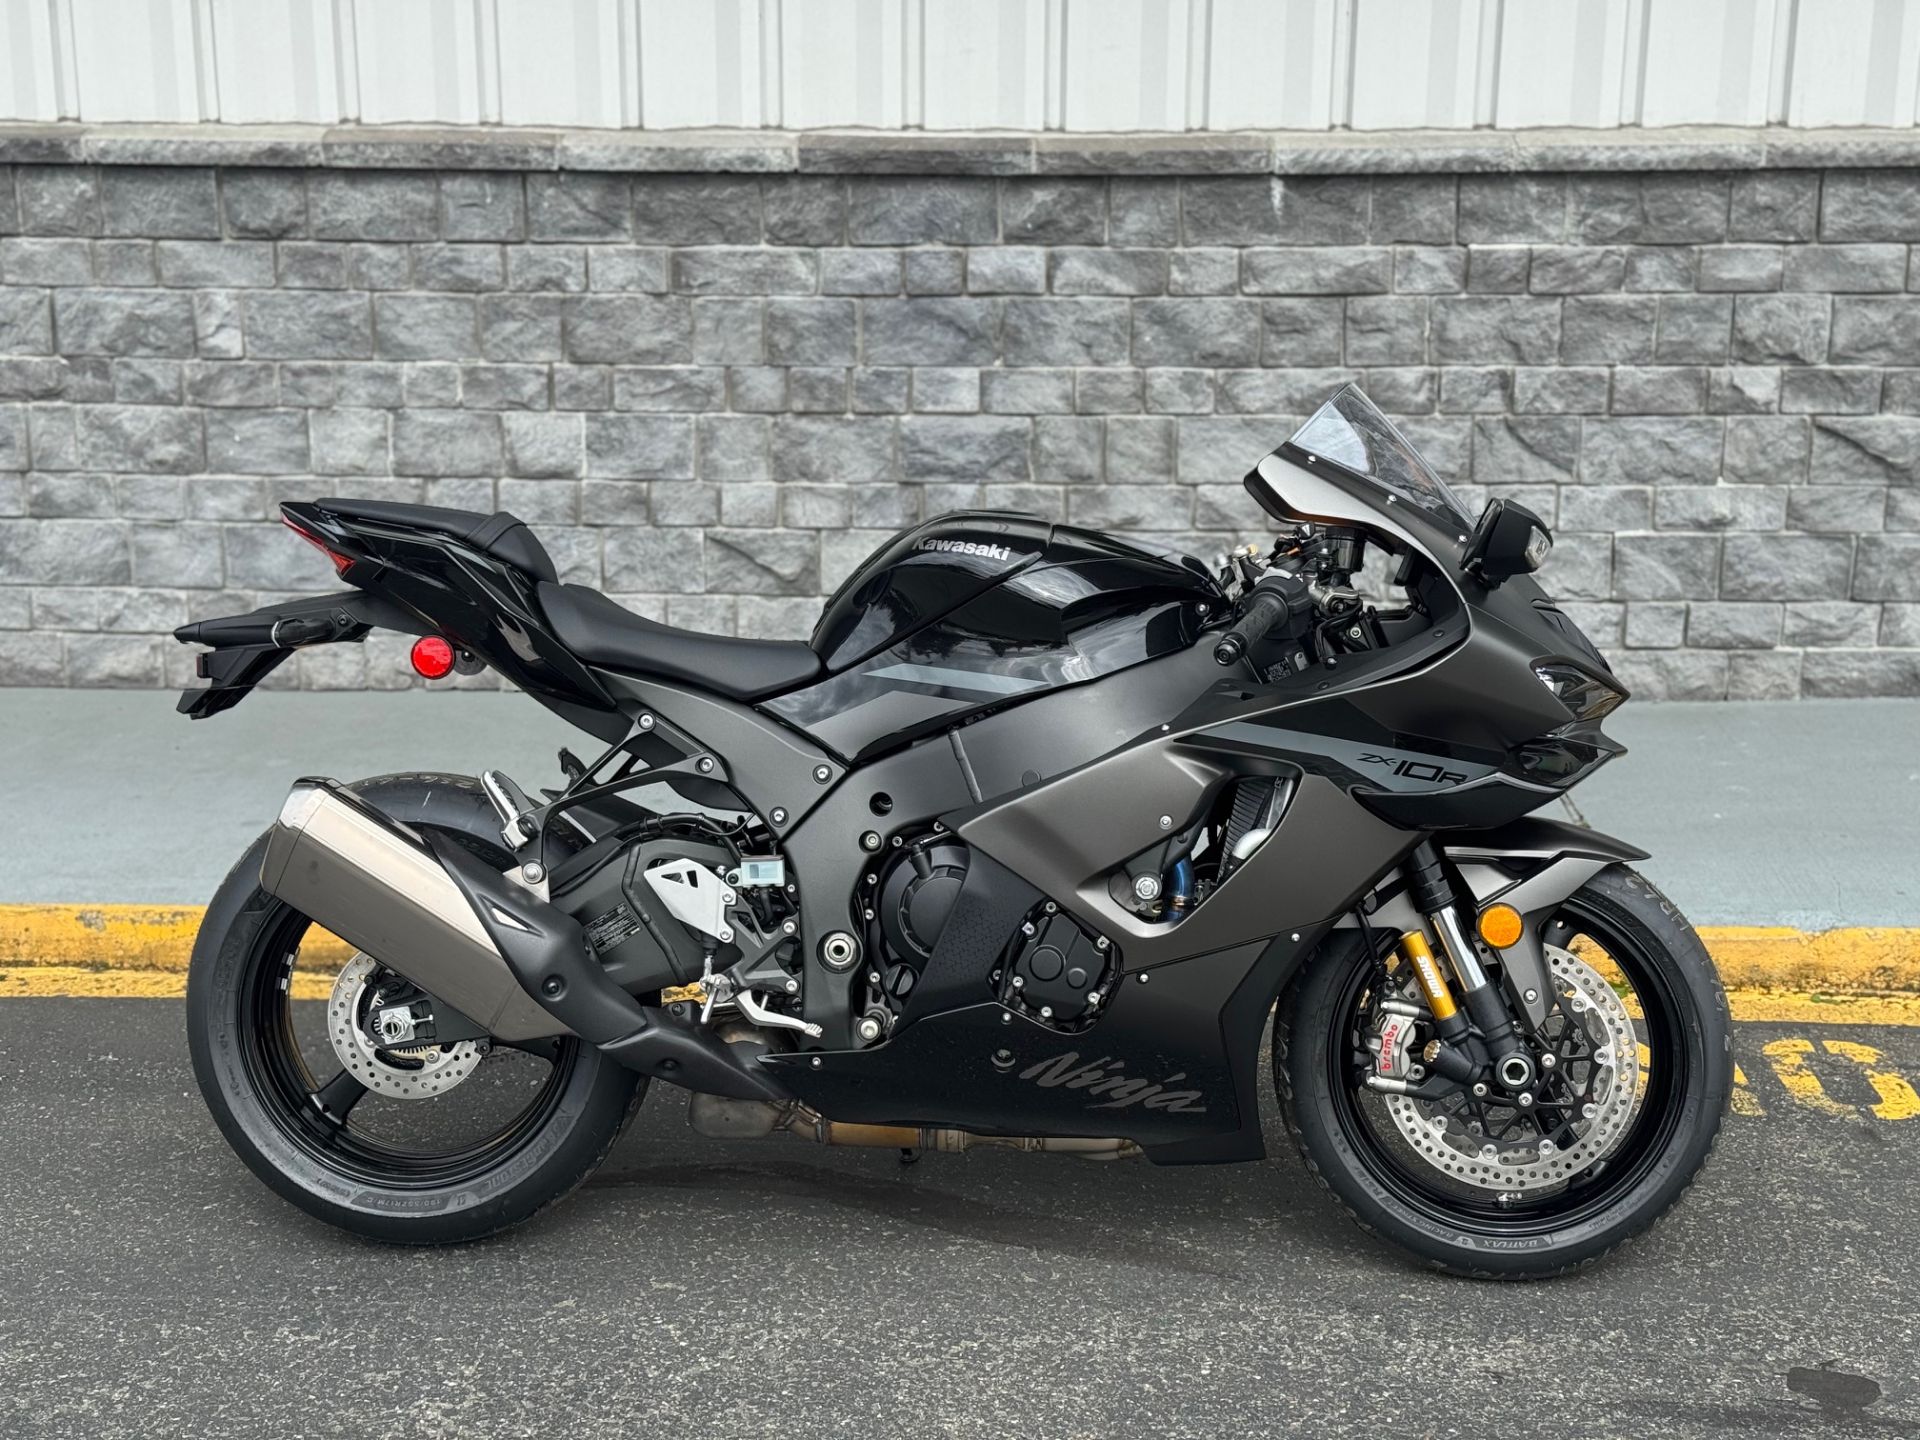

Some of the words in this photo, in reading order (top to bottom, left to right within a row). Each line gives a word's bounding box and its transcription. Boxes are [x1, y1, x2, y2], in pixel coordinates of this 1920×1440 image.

[912, 536, 1011, 561] Kawasaki
[1357, 752, 1468, 786] ZX-10R
[1416, 955, 1445, 998] SHOWA
[1381, 1024, 1398, 1071] brembo
[1019, 1052, 1207, 1113] Ninja
